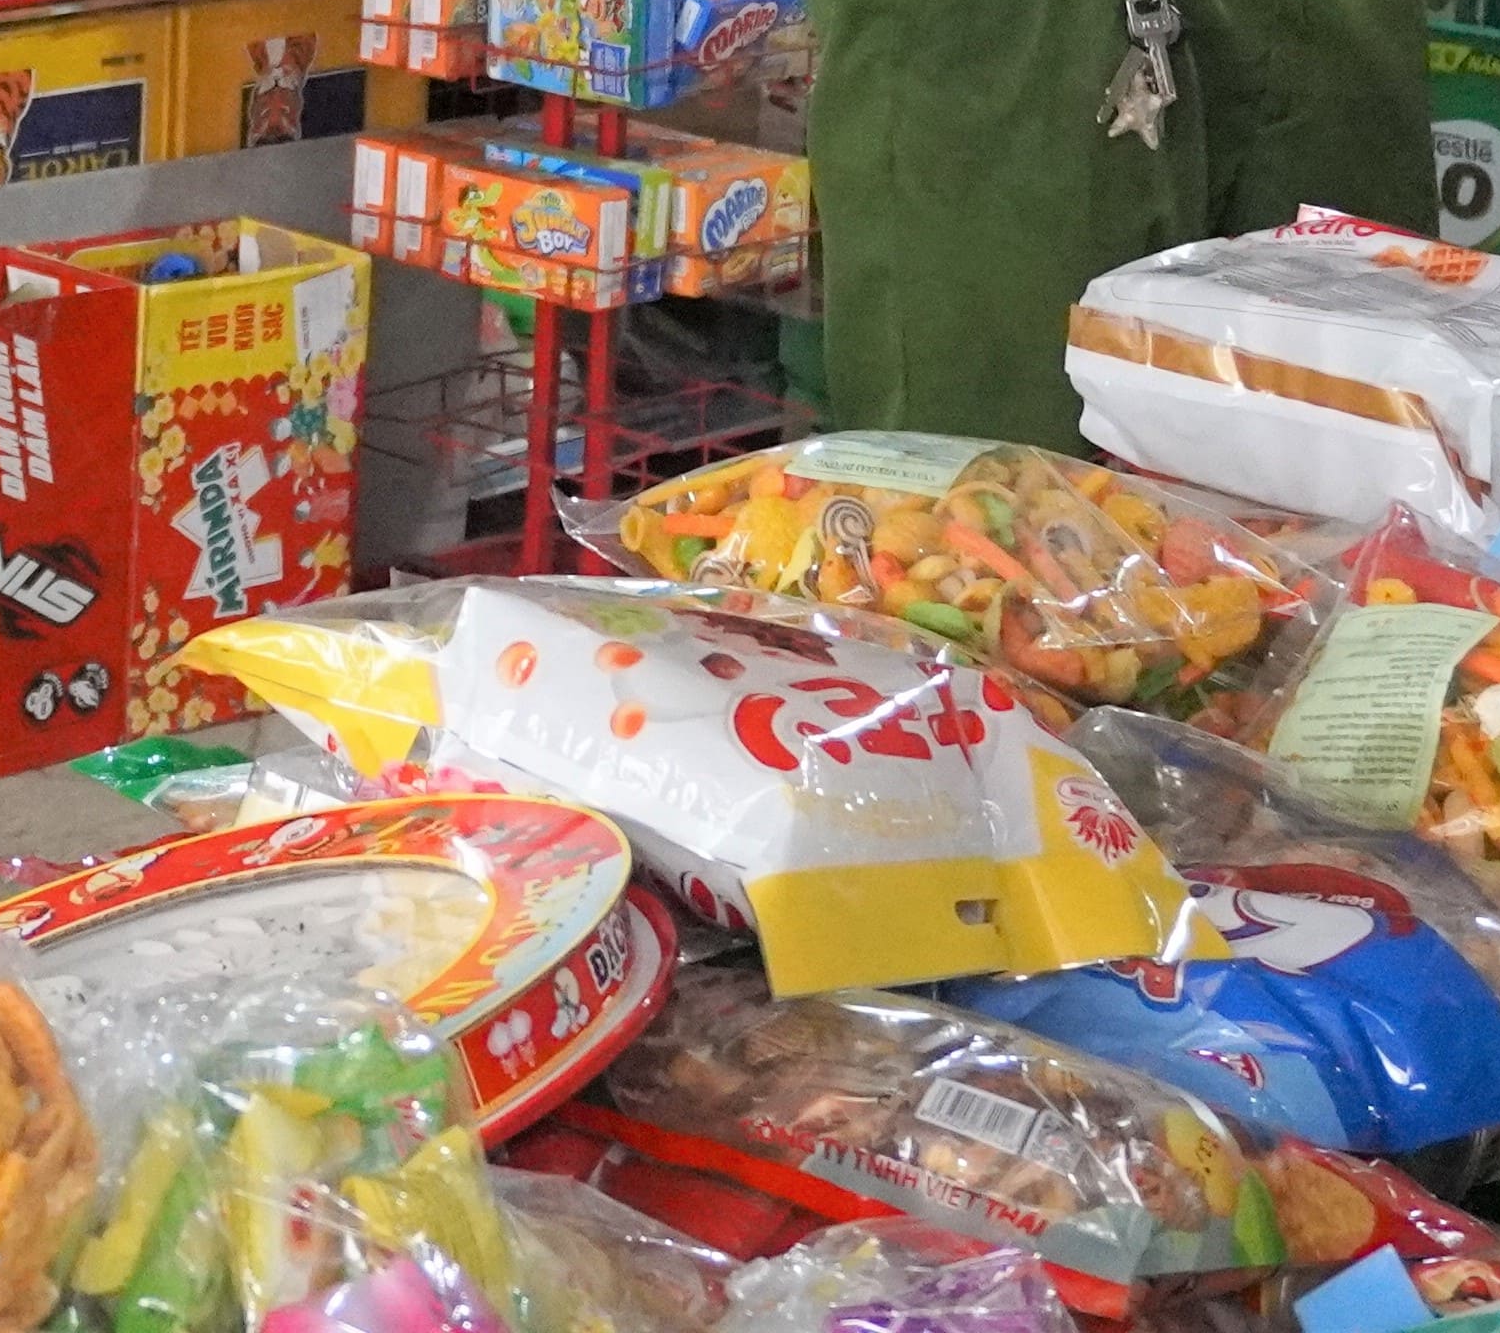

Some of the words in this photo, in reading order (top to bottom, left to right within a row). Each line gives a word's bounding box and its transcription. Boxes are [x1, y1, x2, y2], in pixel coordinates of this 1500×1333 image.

[1436, 133, 1493, 164] estlé
[538, 231, 574, 255] BOY
[853, 1147, 921, 1191] TNHH
